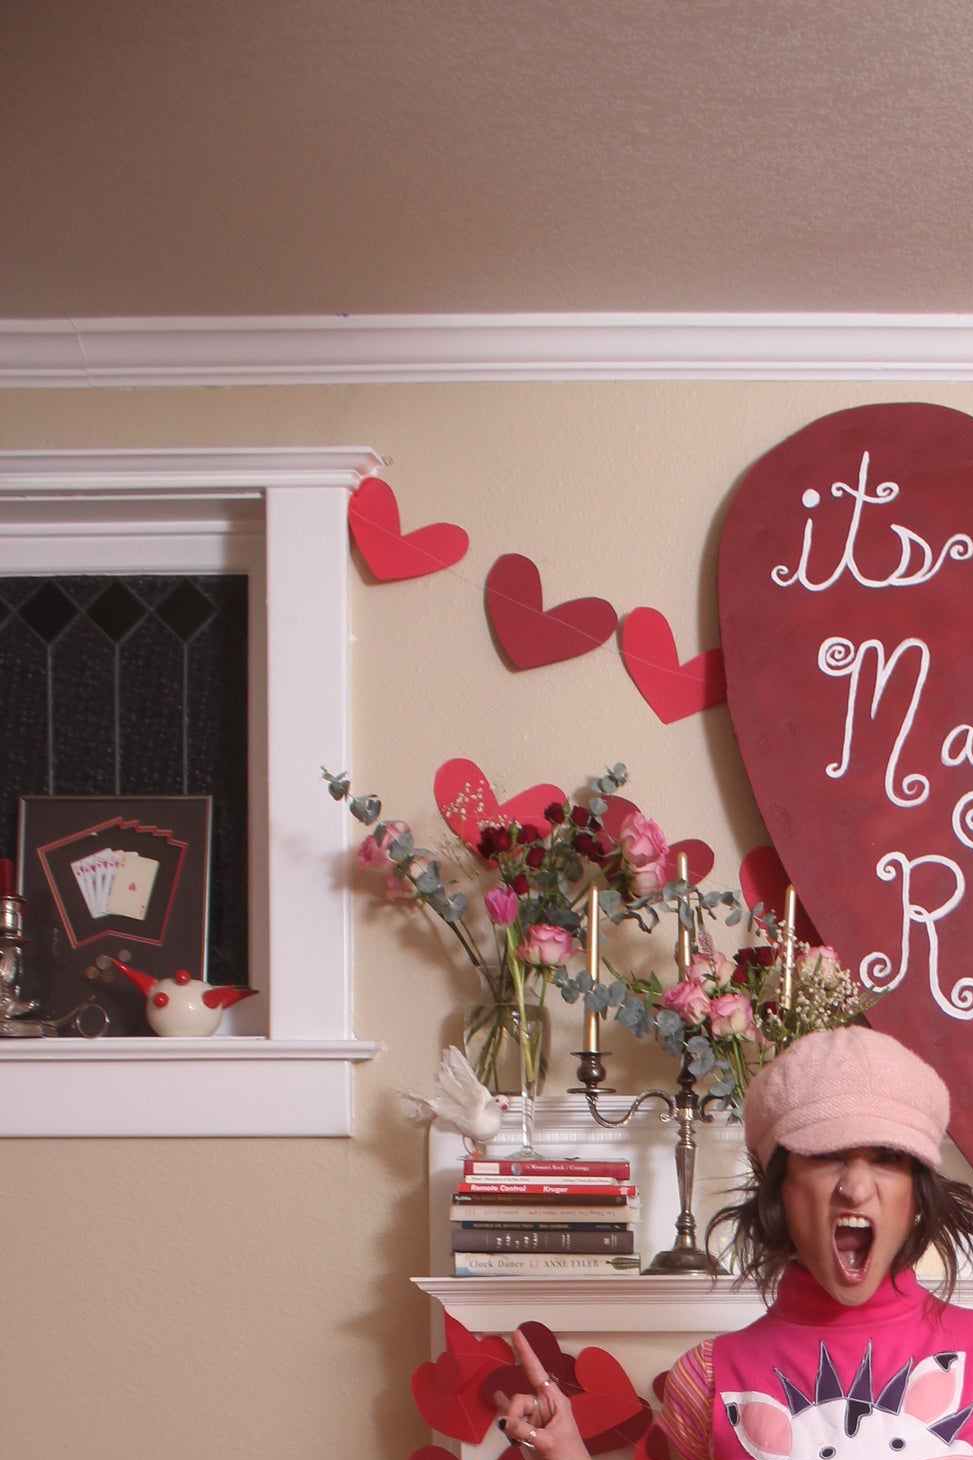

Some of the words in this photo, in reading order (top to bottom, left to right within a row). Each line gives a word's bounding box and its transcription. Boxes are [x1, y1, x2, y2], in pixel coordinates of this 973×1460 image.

[771, 451, 973, 591] its
[500, 1184, 527, 1193] Control
[543, 1185, 569, 1194] Kruger
[469, 1259, 494, 1268] Clock
[498, 1259, 525, 1268] Dance
[544, 1259, 567, 1268] ANNE
[570, 1259, 600, 1268] TYLER
